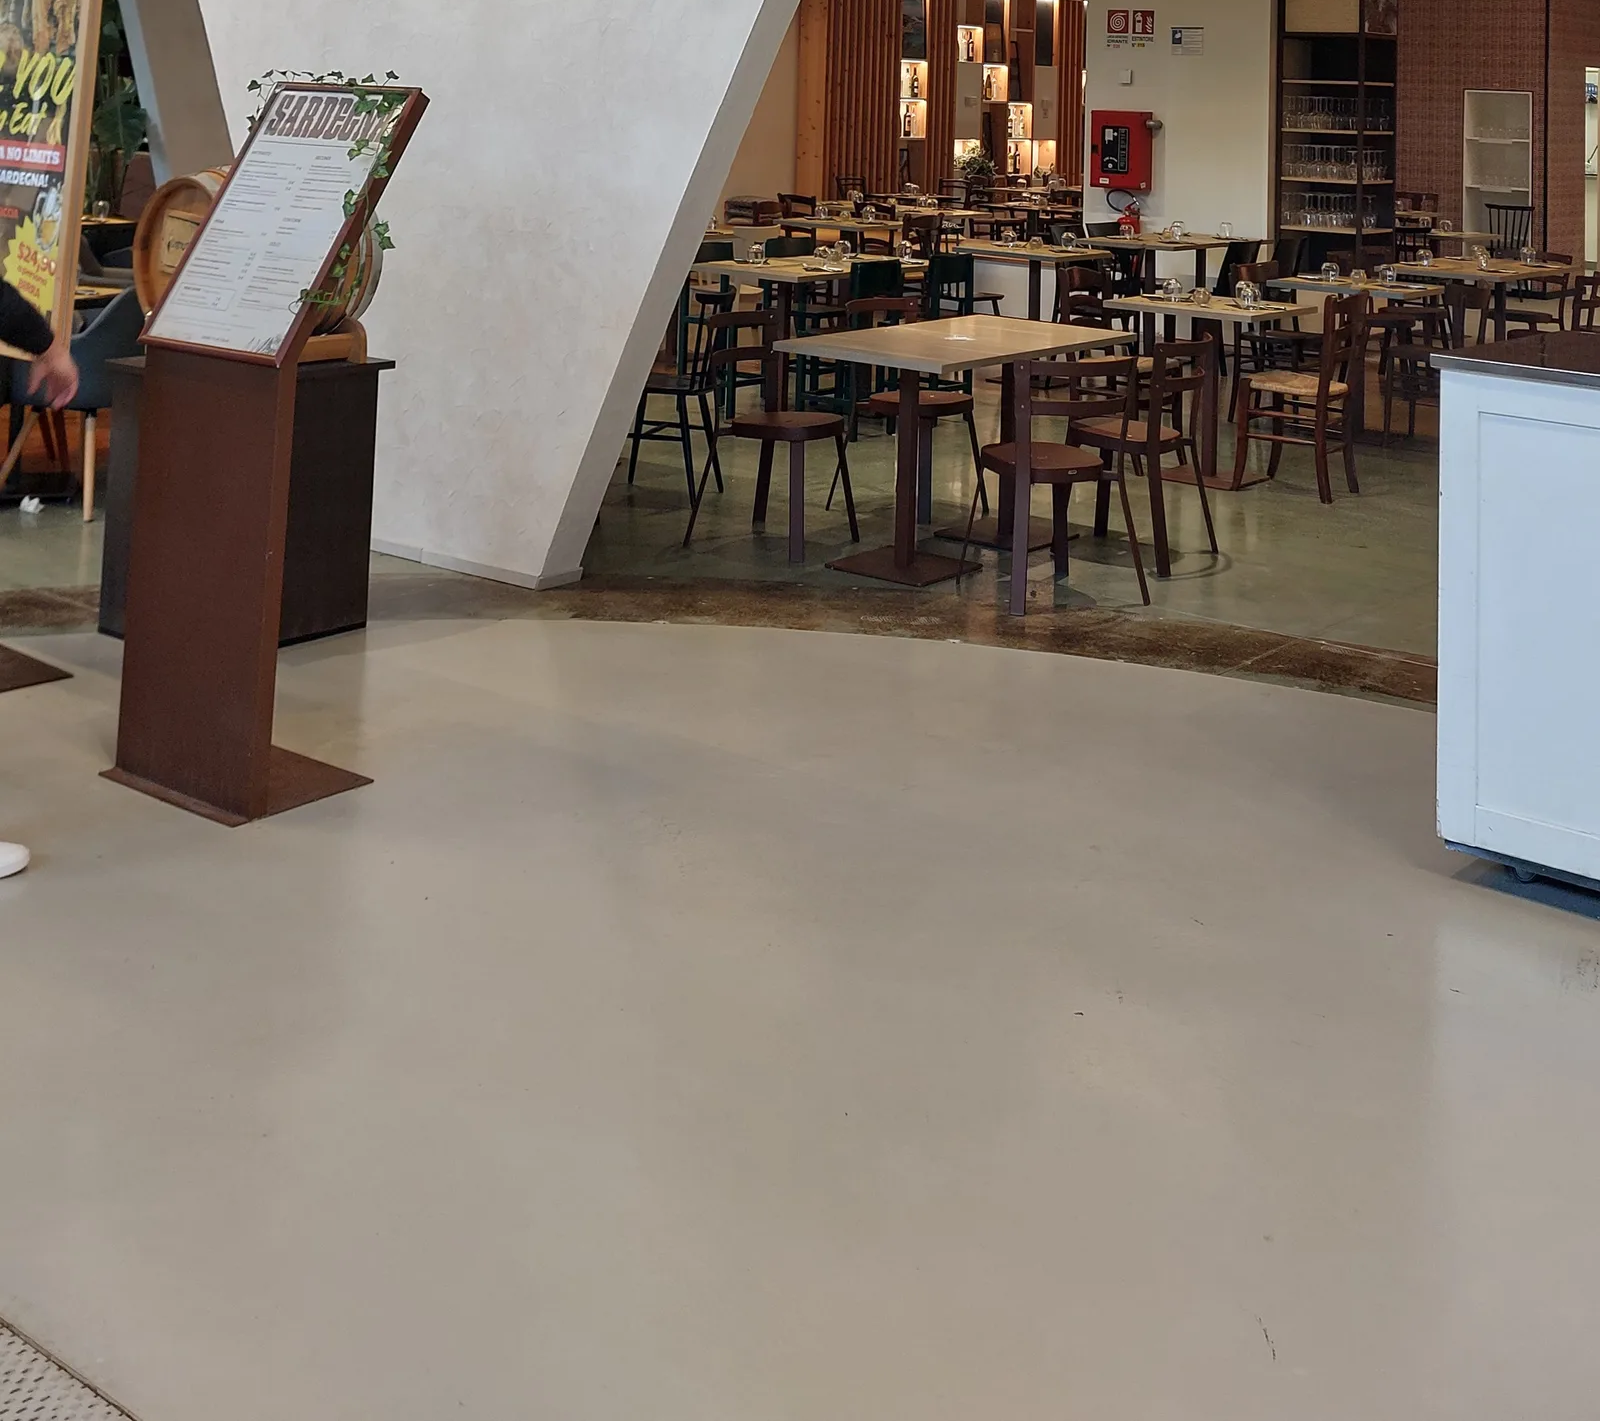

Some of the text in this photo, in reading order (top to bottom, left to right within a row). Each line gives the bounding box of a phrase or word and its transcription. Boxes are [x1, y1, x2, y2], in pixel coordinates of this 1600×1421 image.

[12, 48, 76, 106] YOU
[9, 101, 48, 135] Eat
[6, 146, 22, 160] NO
[22, 148, 60, 166] LIMITS
